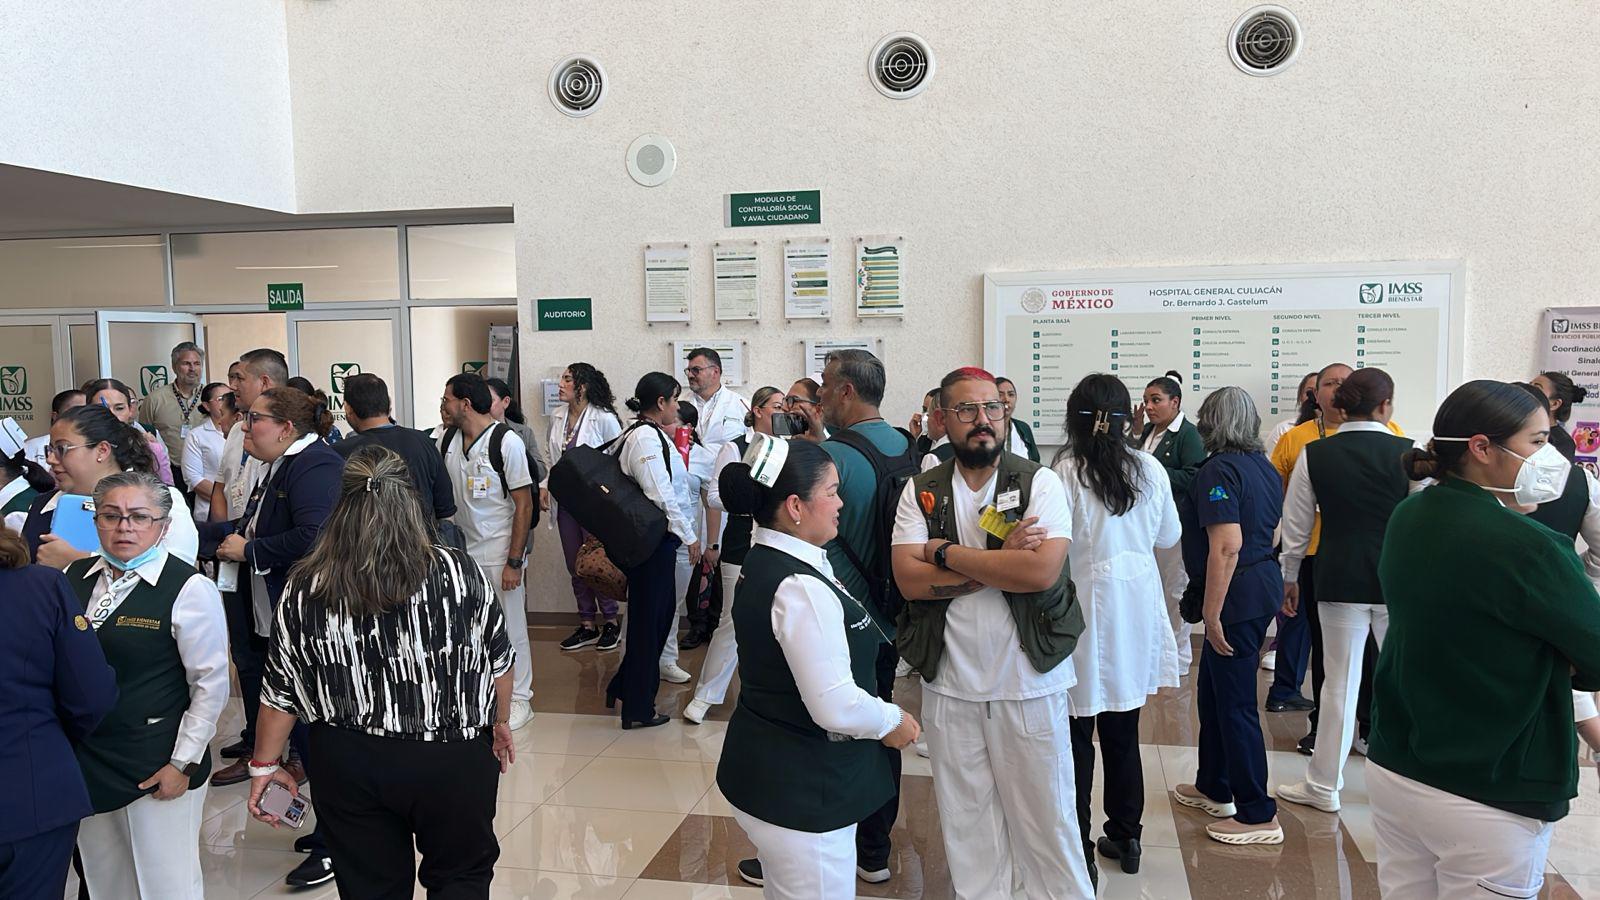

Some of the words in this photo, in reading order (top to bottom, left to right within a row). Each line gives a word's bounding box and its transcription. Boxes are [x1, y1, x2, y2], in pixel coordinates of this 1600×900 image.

[738, 204, 787, 213] CONTRALORÍA
[1051, 289, 1100, 297] GOBIERNO
[1149, 288, 1192, 296] HOSPITAL
[1194, 288, 1235, 296] GENERAL
[1236, 286, 1283, 294] CULIACÁN
[1388, 282, 1422, 294] IMSS
[269, 290, 302, 304] SALIDA
[1226, 298, 1268, 306] Gastelum
[1052, 296, 1114, 310] MÉXICO
[1570, 322, 1592, 330] IMSS
[0, 396, 32, 411] IMSS
